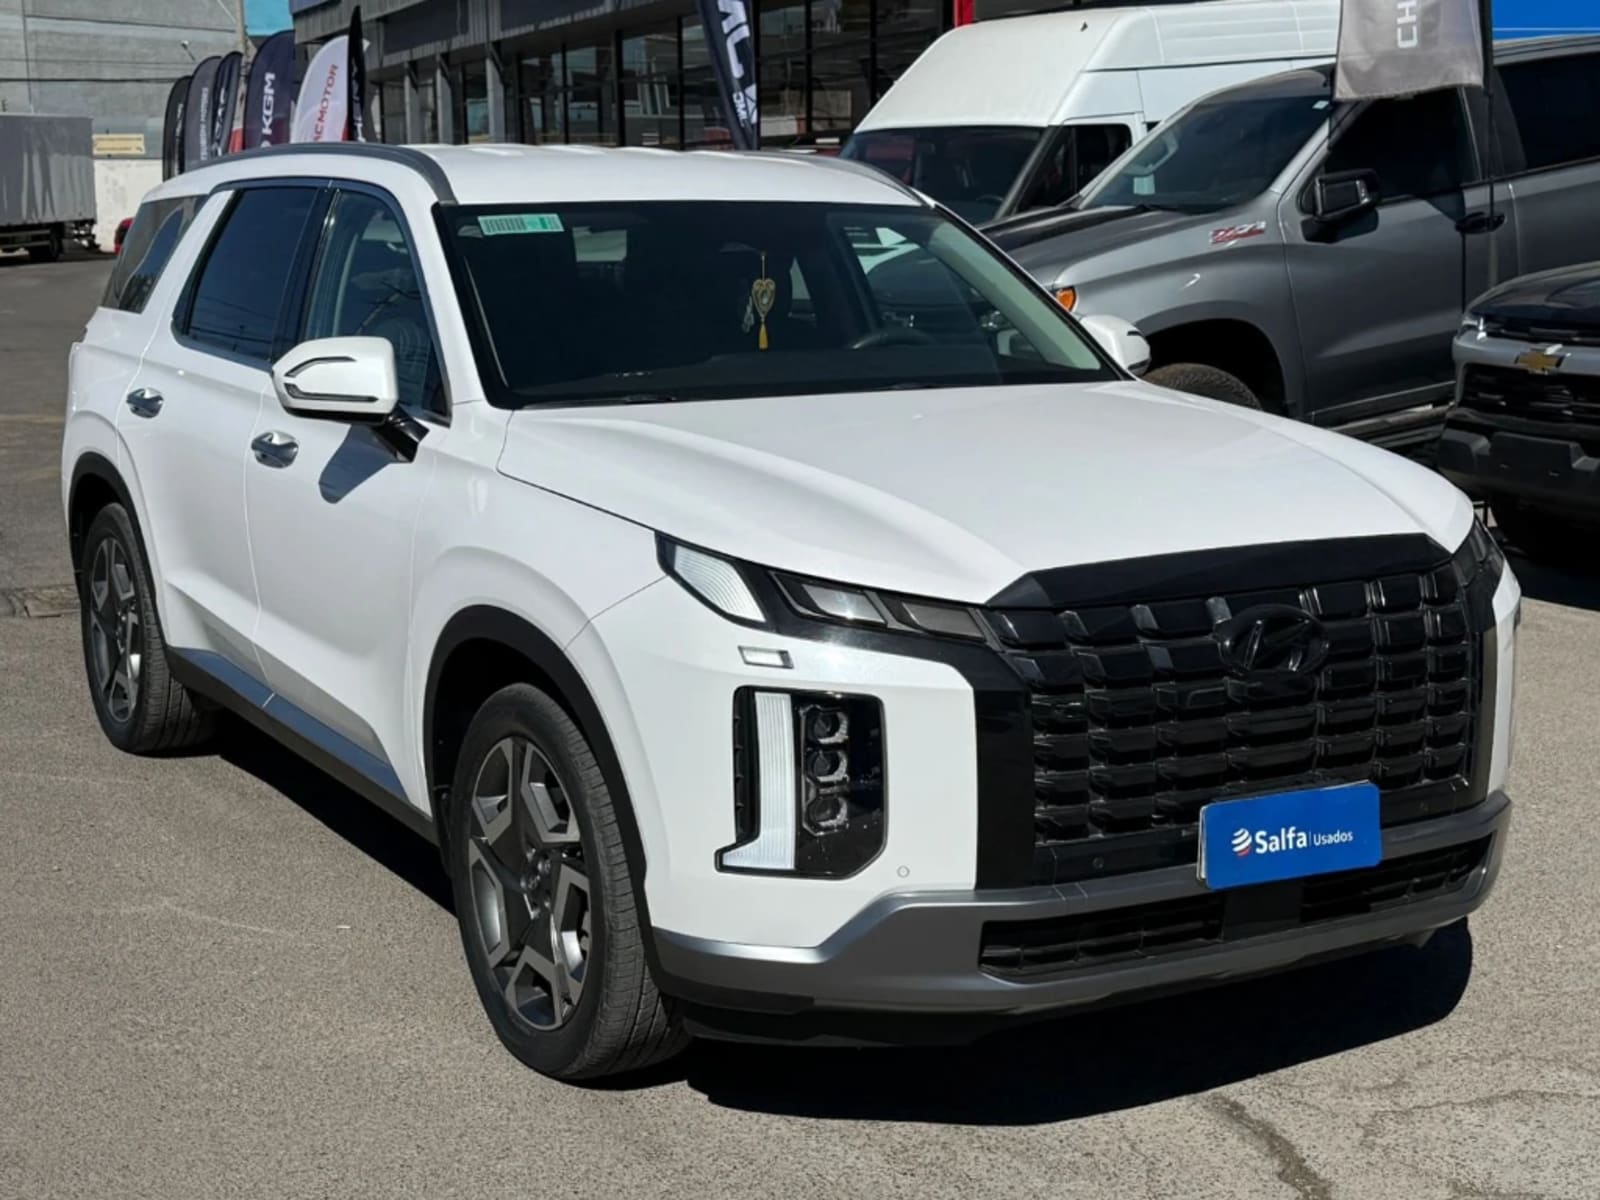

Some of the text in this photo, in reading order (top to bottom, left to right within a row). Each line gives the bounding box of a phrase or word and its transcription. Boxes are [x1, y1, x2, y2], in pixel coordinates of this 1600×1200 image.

[1397, 0, 1417, 48] CH
[262, 72, 275, 135] KGM
[1255, 826, 1354, 854] Salfa Usados
